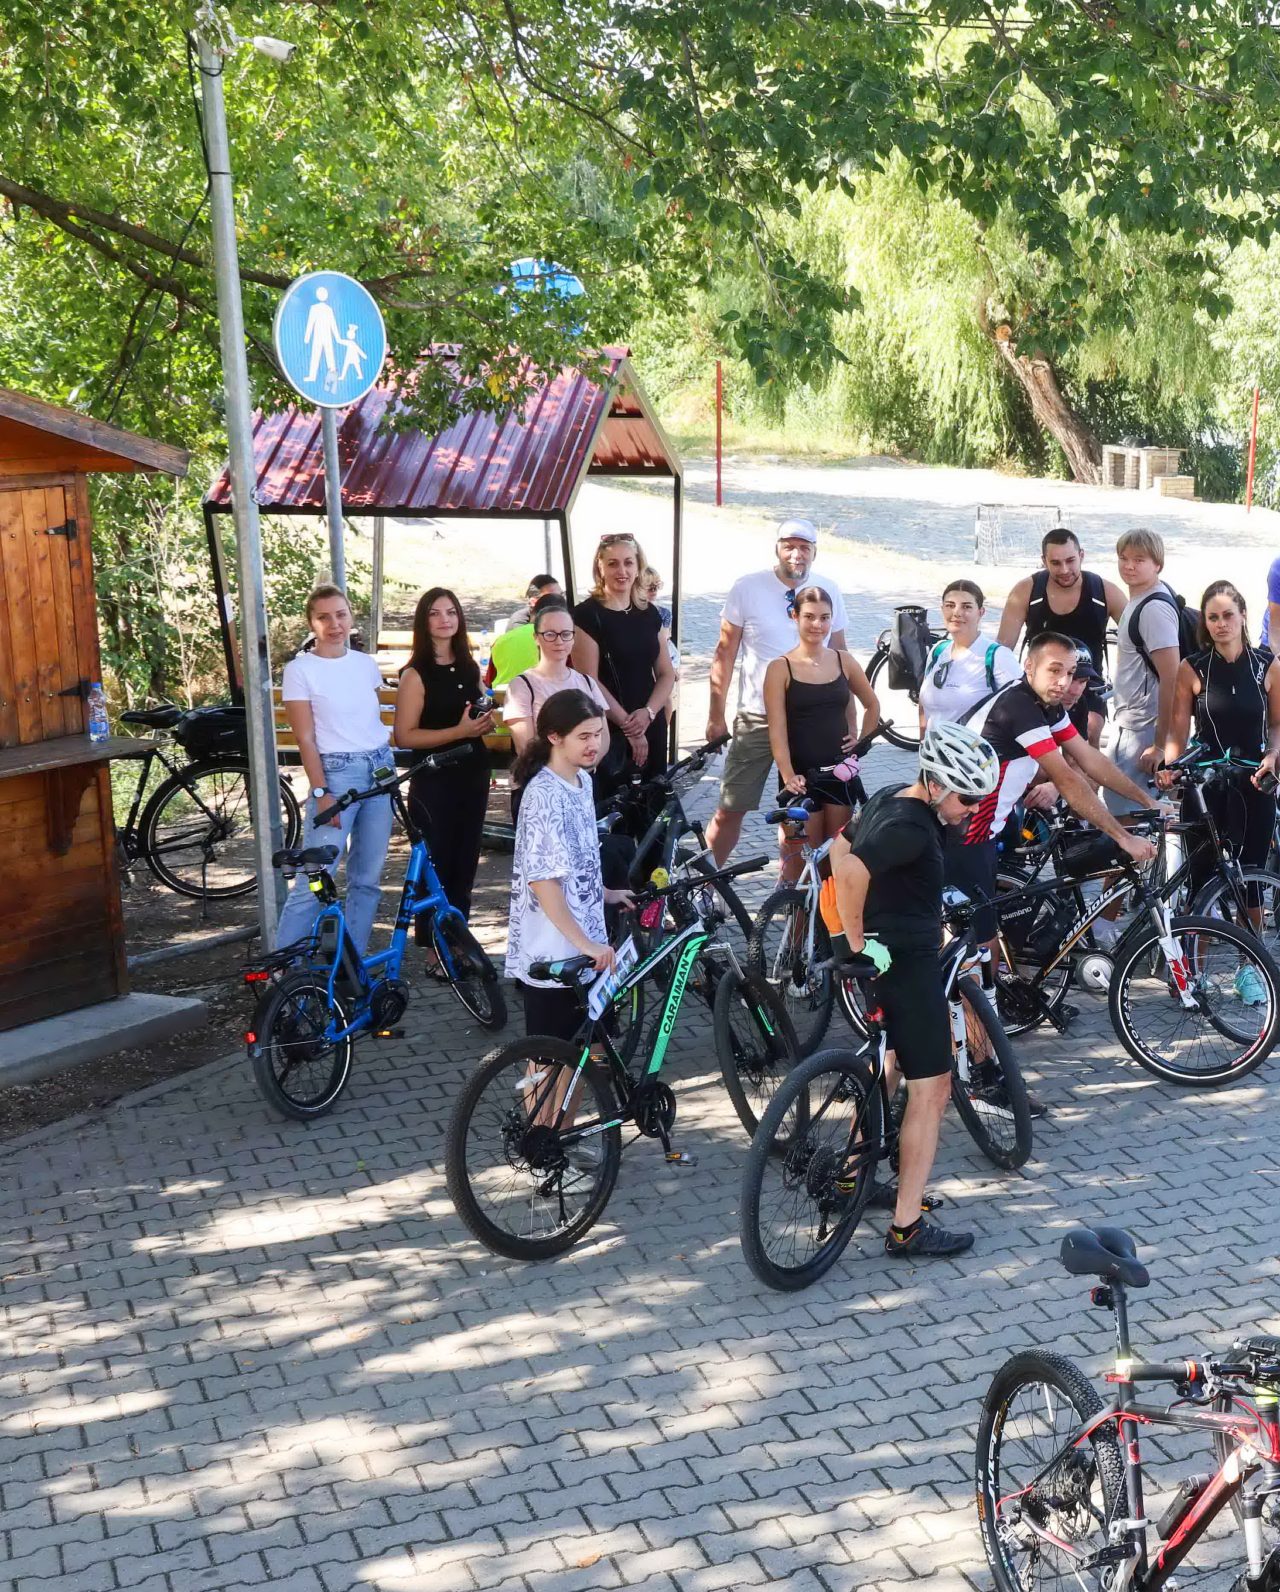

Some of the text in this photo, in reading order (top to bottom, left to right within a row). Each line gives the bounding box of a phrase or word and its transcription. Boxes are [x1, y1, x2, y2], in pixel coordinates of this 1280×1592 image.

[1001, 906, 1033, 921] SHIMANO
[1058, 887, 1114, 951] capriolo
[663, 958, 691, 1035] CARAIMAN
